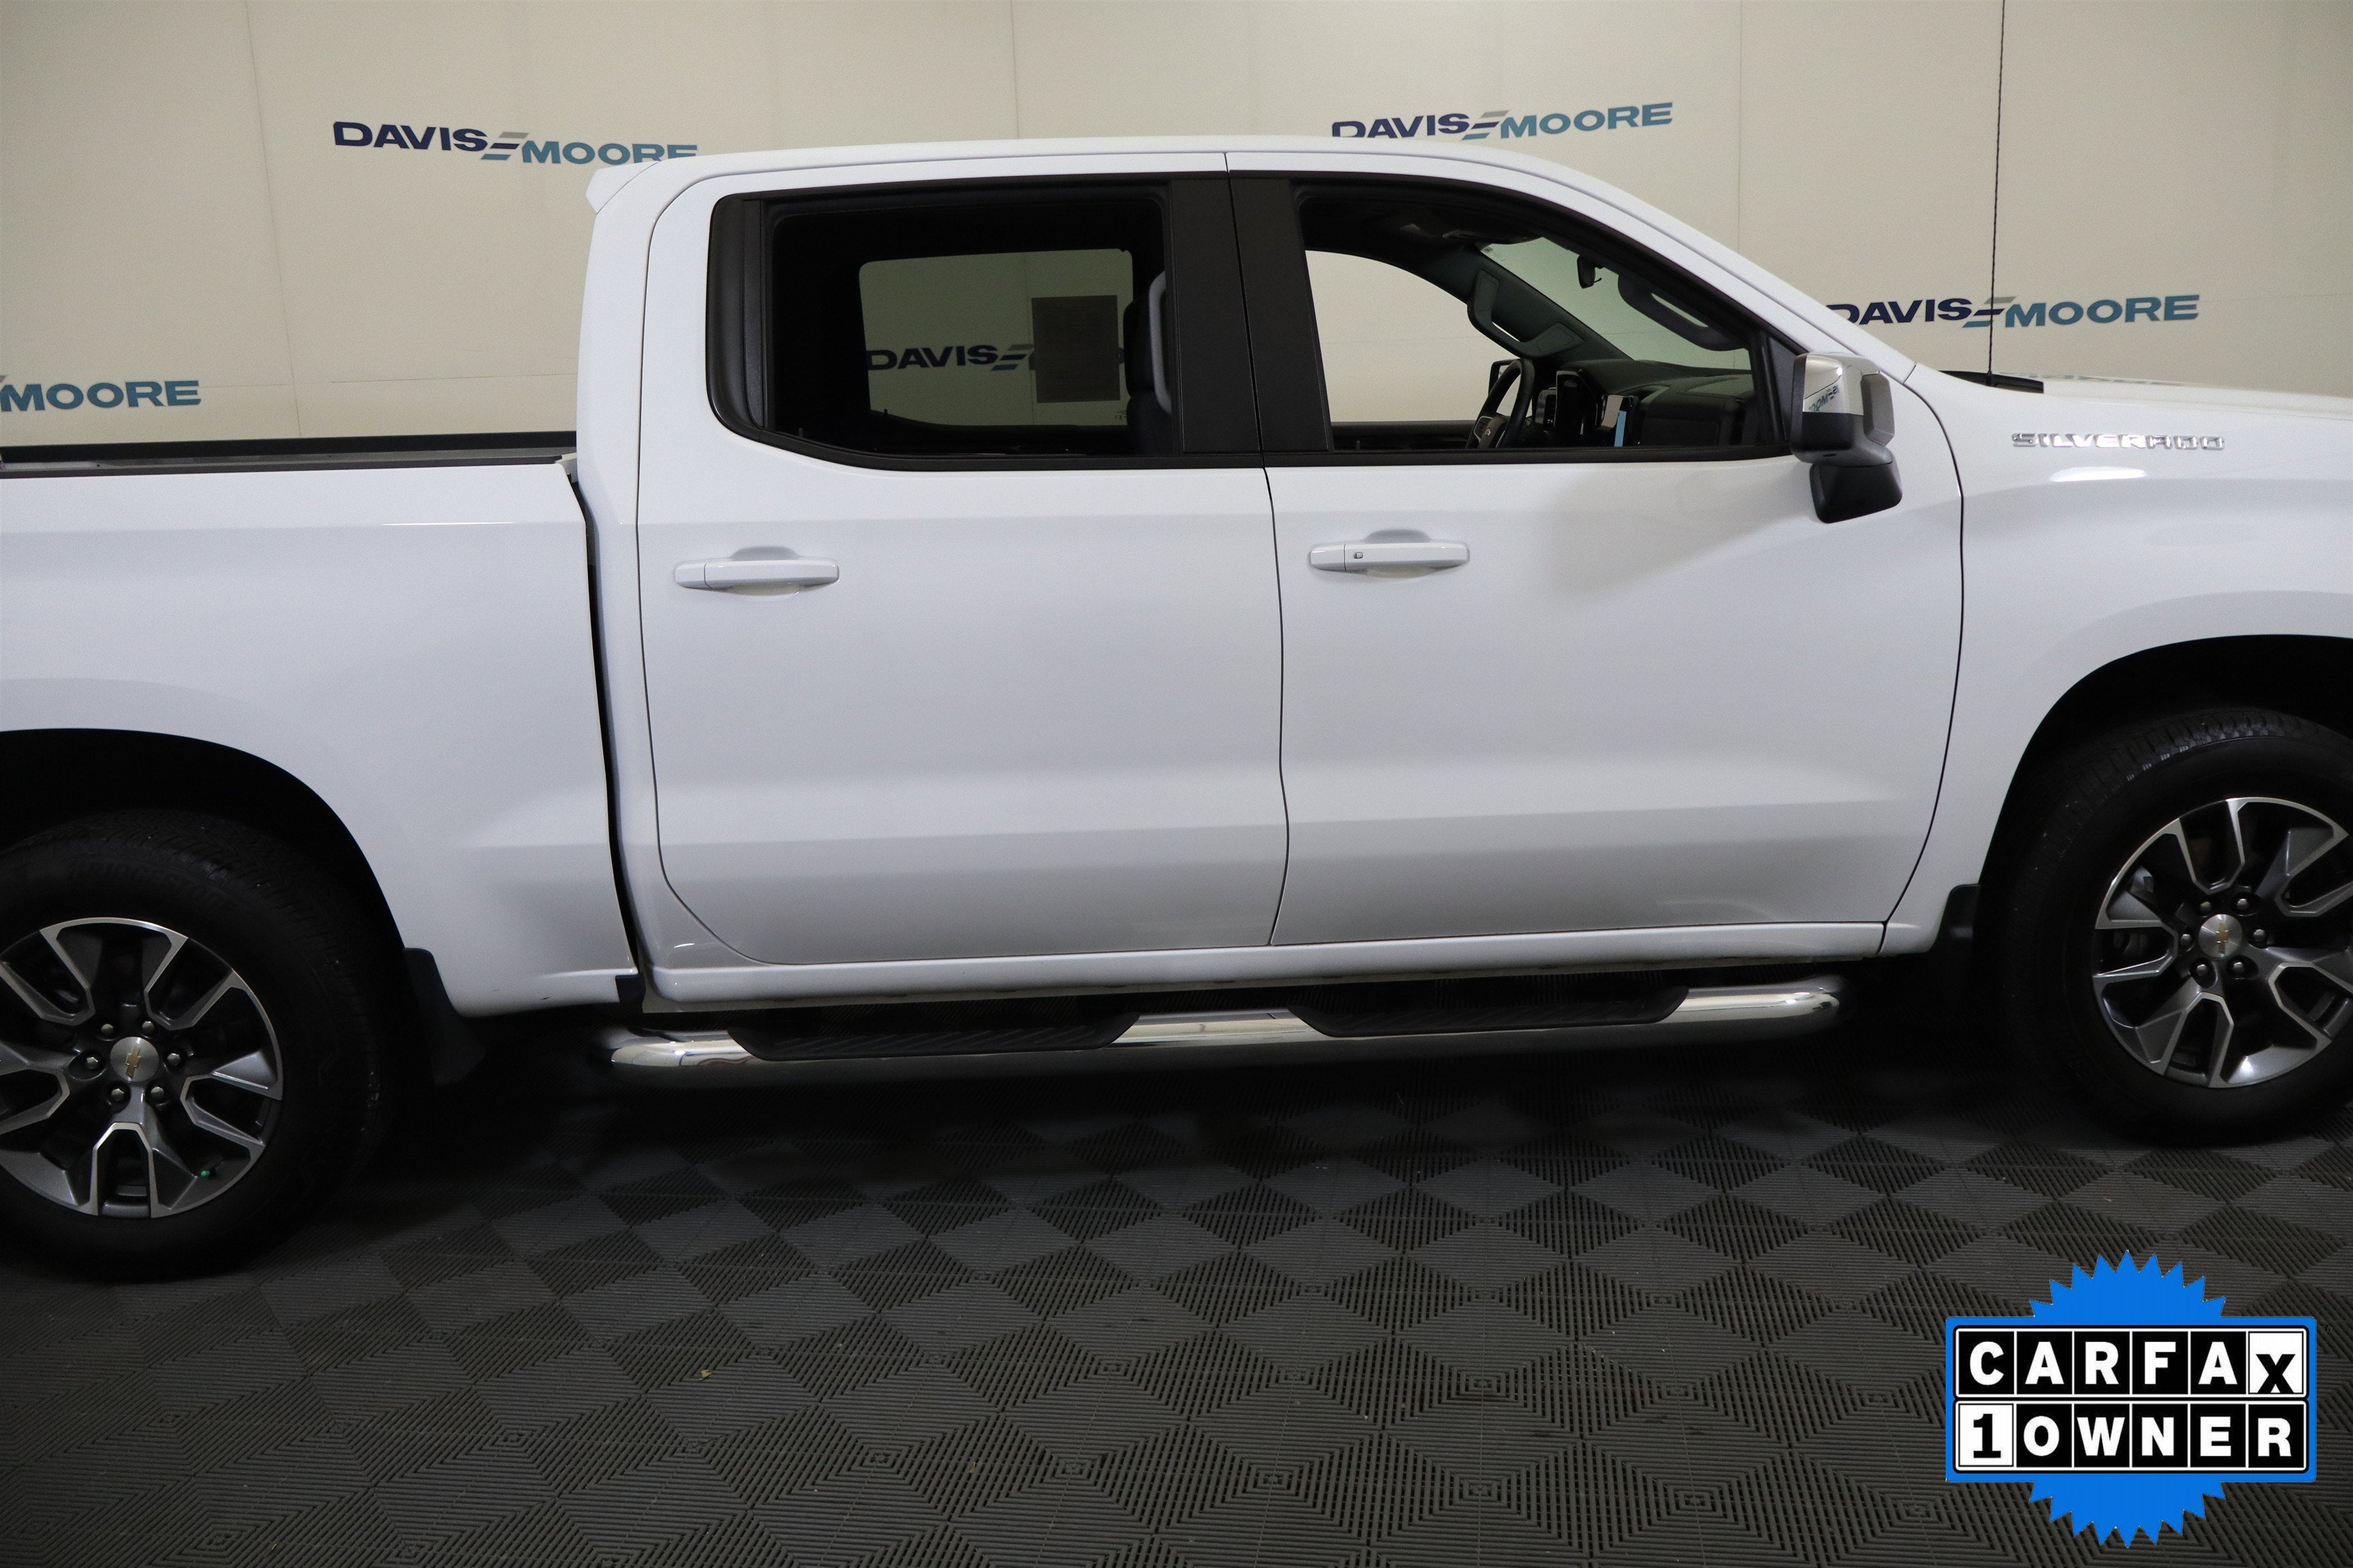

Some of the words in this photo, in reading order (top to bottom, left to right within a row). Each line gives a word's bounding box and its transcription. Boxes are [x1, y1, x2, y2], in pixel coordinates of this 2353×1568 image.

[1332, 113, 1470, 138] DAVIS
[1500, 102, 1673, 139] MOORE
[333, 121, 488, 152] DAVIS
[2005, 294, 2200, 327] MOORE
[866, 345, 998, 371] DAVIS
[0, 380, 201, 412] MOORE
[2012, 432, 2225, 450] SILVERADO
